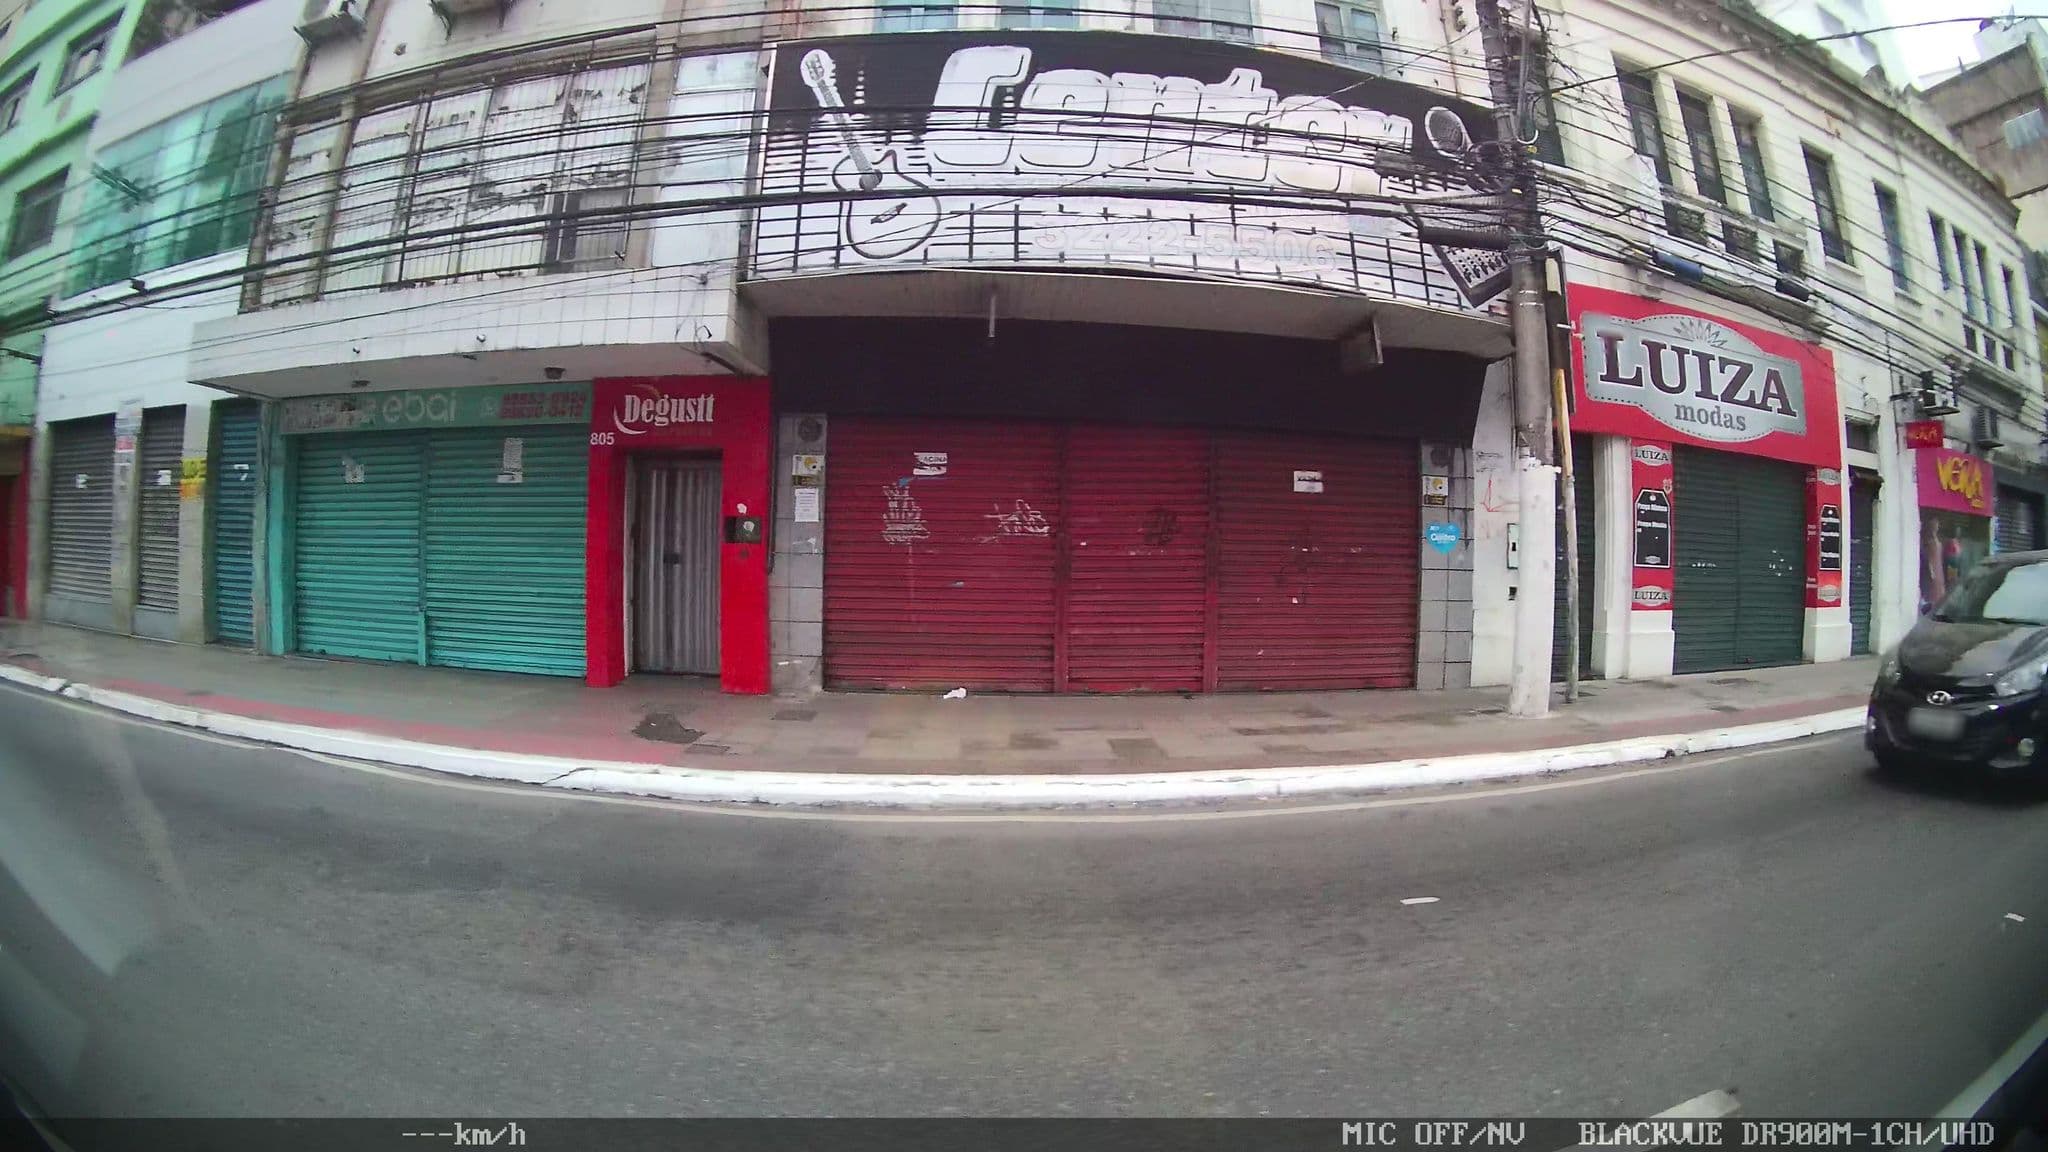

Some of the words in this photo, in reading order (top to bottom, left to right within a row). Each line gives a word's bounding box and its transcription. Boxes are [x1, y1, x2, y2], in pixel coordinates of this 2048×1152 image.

[1596, 331, 1798, 417] LUIZA
[1673, 403, 1747, 432] modas
[589, 432, 615, 446] 805
[1635, 449, 1669, 461] LUIZA
[1634, 589, 1669, 601] LUIZA
